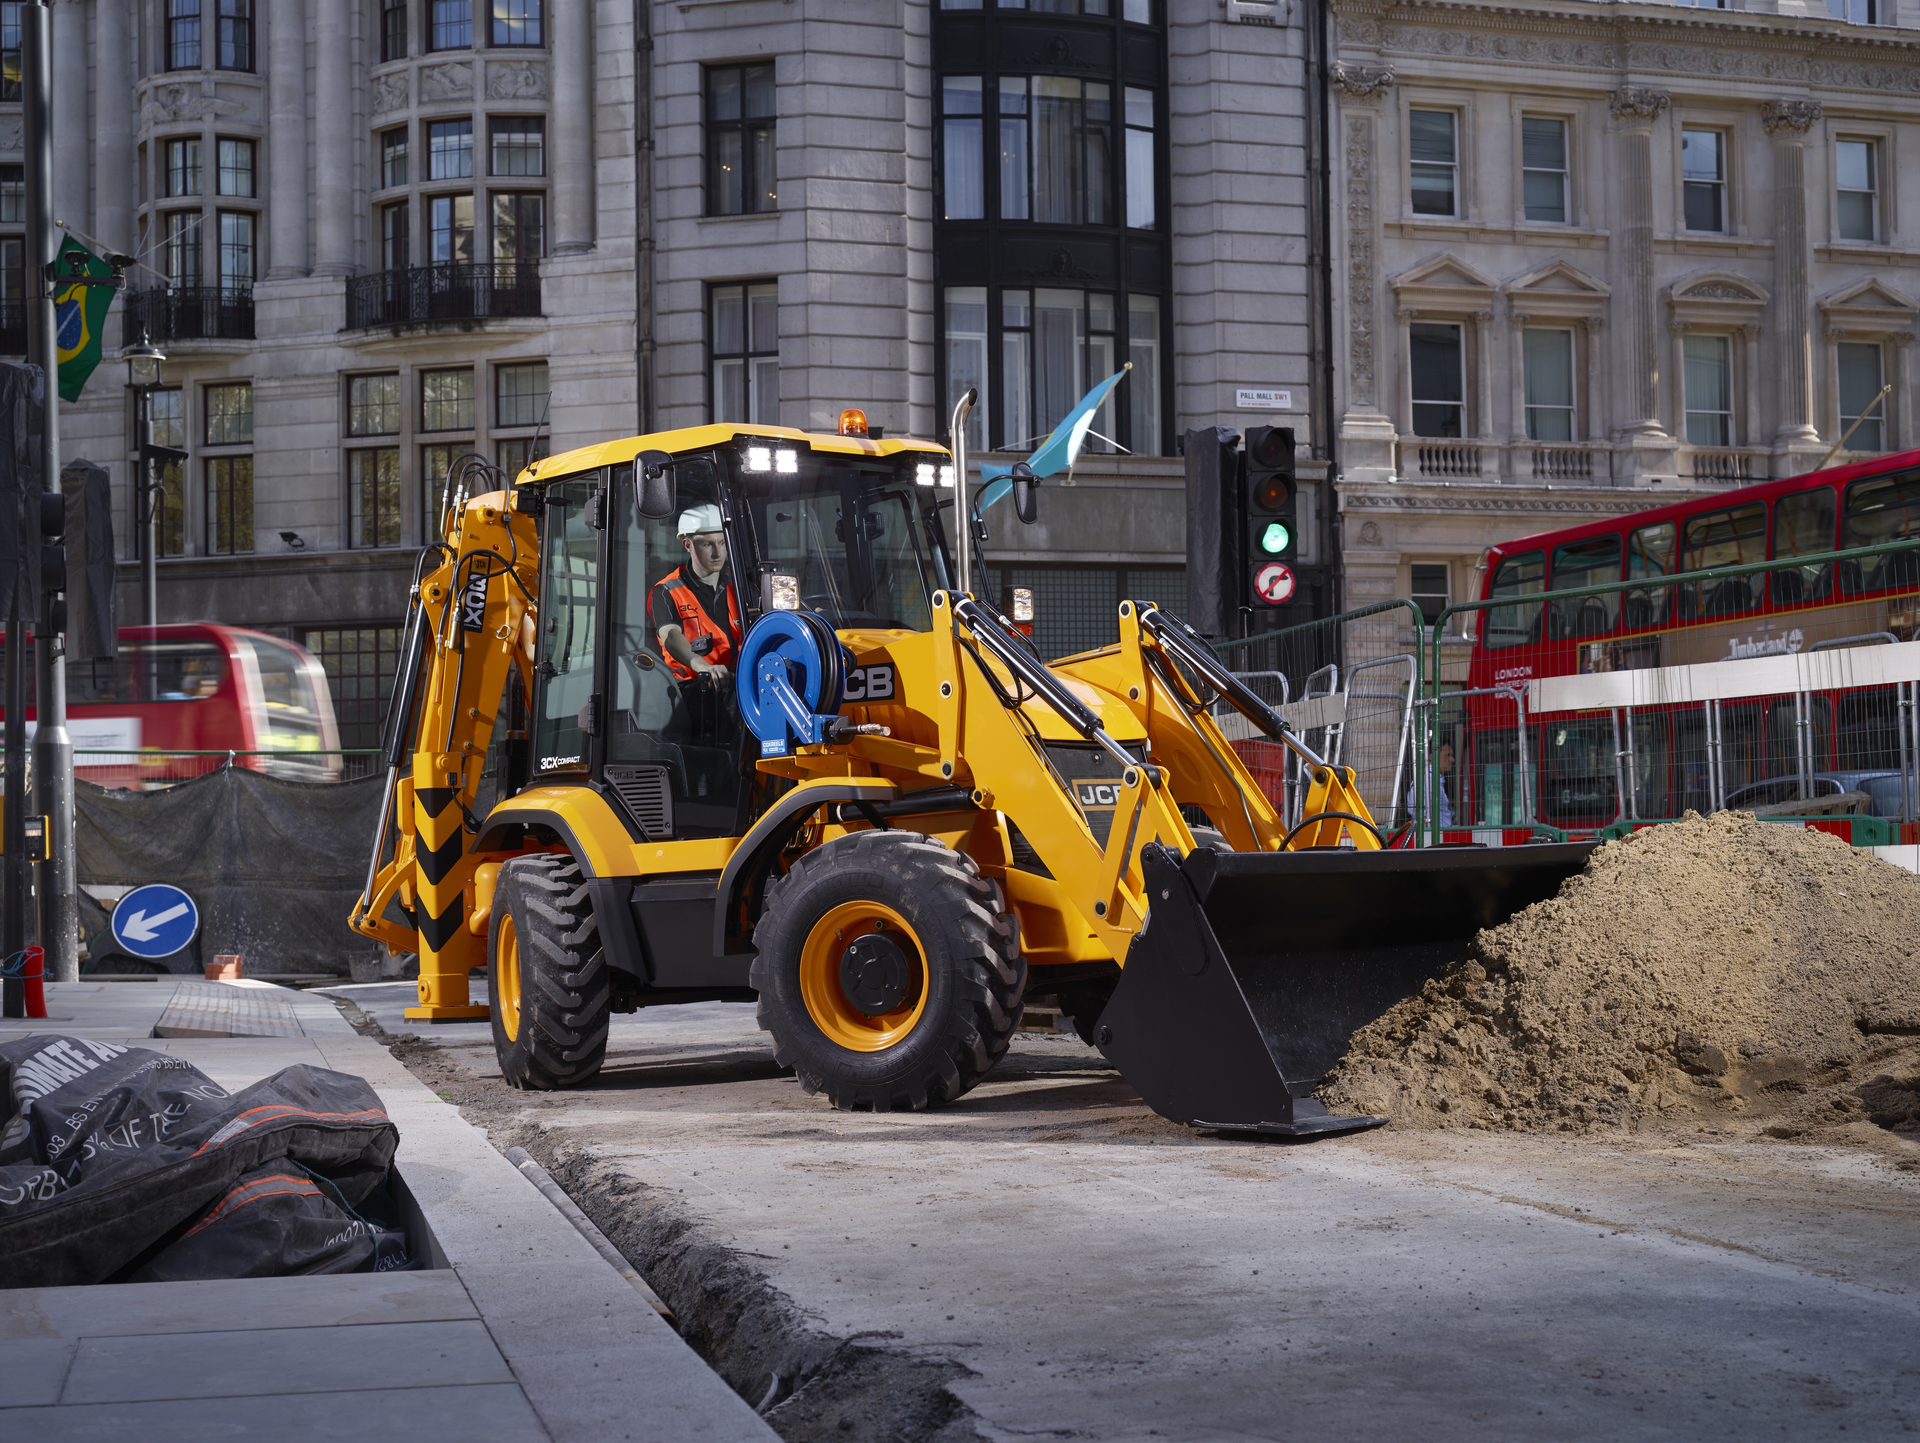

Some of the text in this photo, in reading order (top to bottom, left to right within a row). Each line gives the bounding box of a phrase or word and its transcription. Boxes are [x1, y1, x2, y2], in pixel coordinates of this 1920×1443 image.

[1240, 392, 1255, 400] PALL
[1256, 392, 1273, 400] MALL
[1494, 665, 1532, 680] LONDON
[843, 666, 893, 700] CB
[540, 755, 580, 769] 3CX COMPACT
